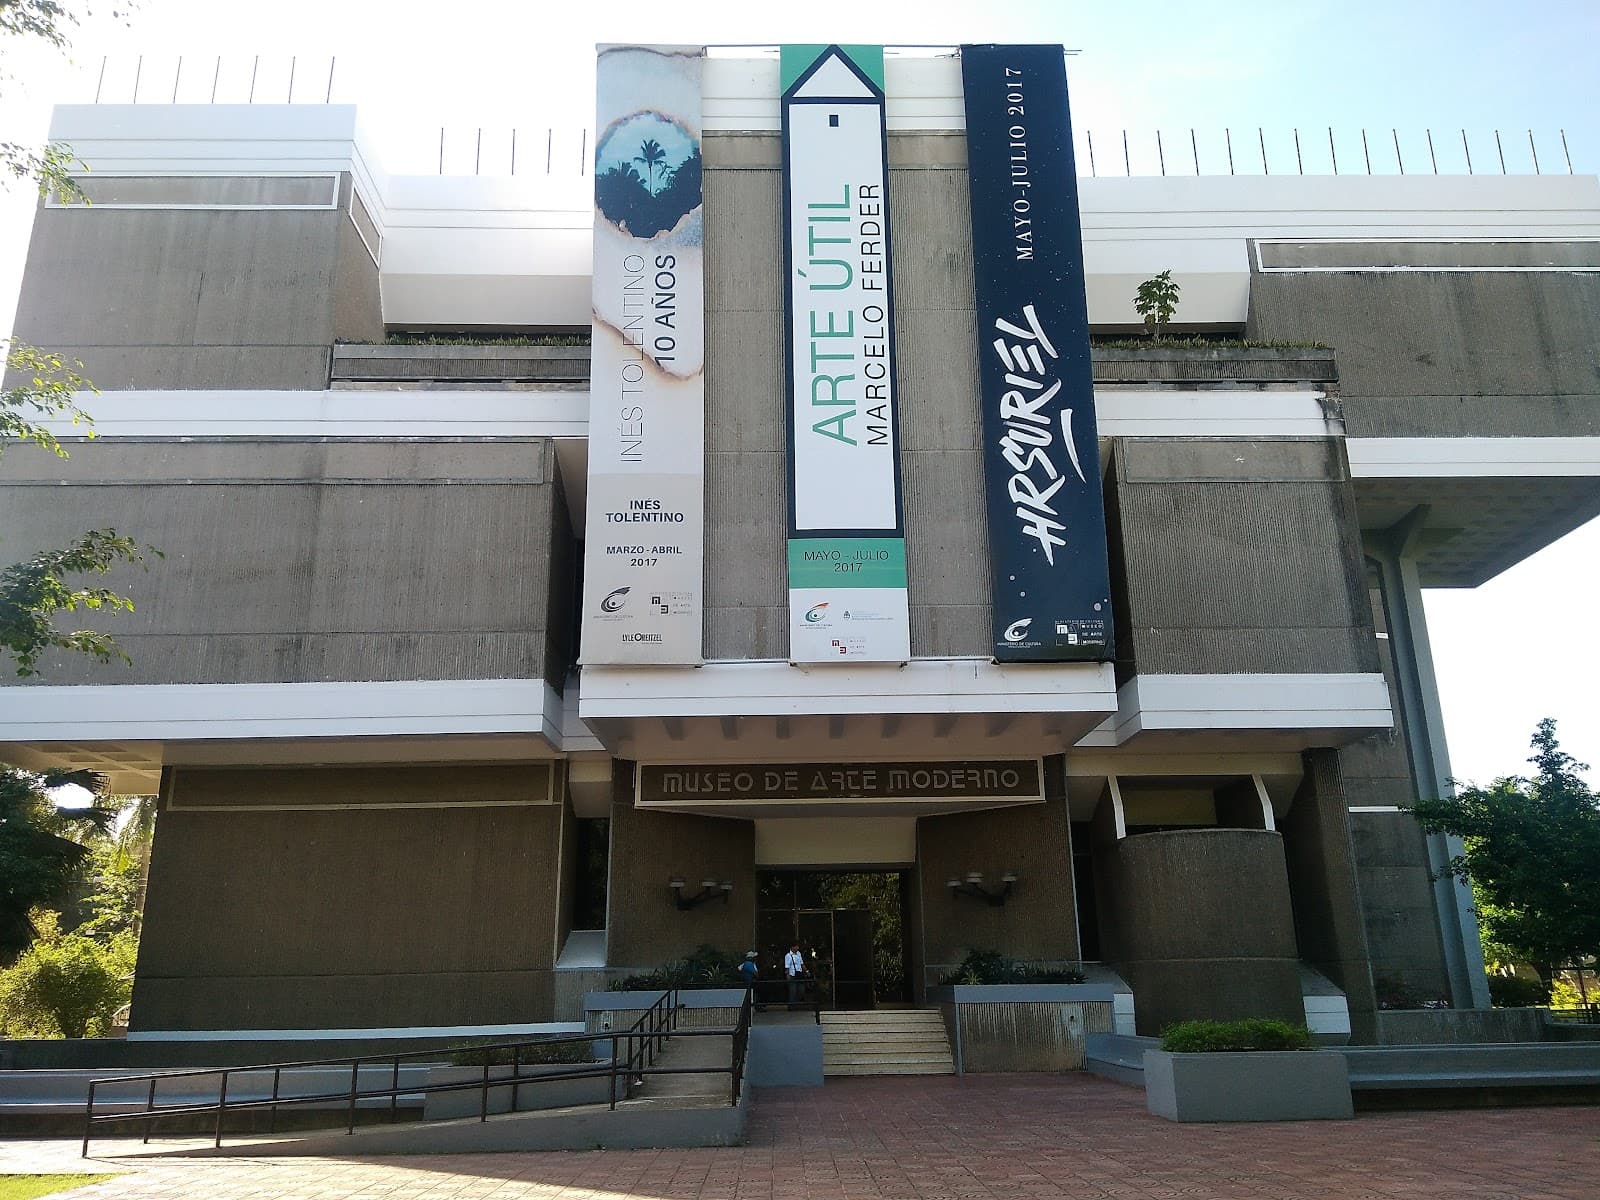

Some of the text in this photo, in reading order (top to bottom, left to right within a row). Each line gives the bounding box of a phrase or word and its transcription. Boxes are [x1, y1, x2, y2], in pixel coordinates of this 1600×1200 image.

[1005, 67, 1025, 116] 2017
[651, 254, 676, 369] 10 AÑOS
[798, 184, 857, 446] ARTE ÚTIL
[859, 184, 888, 445] MARCELO FERDER
[617, 254, 645, 462] INÉS TOLENTINO
[630, 498, 661, 510] INÉS
[606, 512, 684, 523] TOLENTINO
[630, 558, 658, 567] 2017
[804, 550, 841, 561] MAYO
[853, 550, 889, 561] JULIO
[834, 562, 863, 573] 2017
[663, 769, 1020, 793] MUSEO DE ARTE MODERNO
